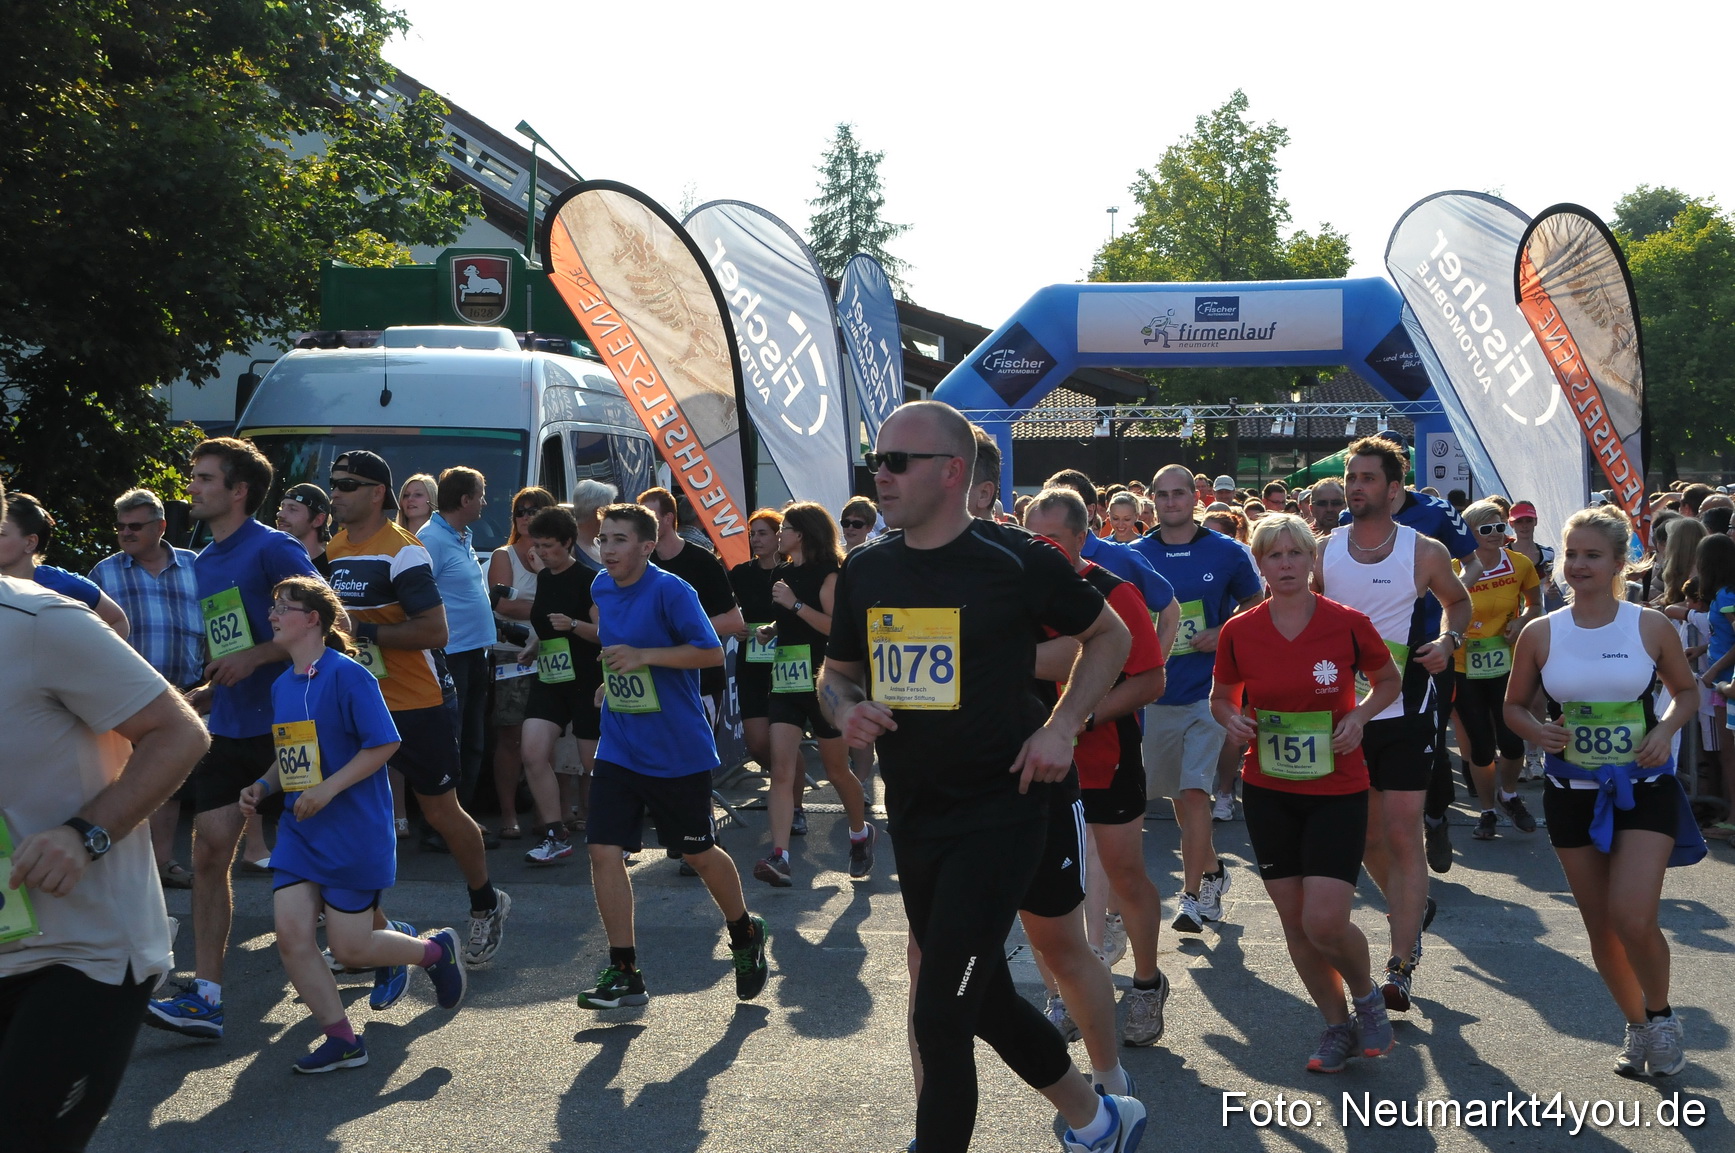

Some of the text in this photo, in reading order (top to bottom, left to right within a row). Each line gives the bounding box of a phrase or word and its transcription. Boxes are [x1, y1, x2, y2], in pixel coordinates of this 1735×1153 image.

[469, 308, 494, 318] 1628
[1204, 306, 1237, 314] Fischer
[1179, 322, 1277, 341] firmenlauf
[993, 358, 1045, 368] Fischer
[1400, 351, 1414, 359] das
[333, 578, 369, 591] Fischer
[1491, 576, 1517, 588] BÖGL
[210, 612, 243, 645] 652
[537, 652, 571, 673] 1142
[872, 643, 955, 685] 1078
[1471, 651, 1505, 669] 812
[773, 661, 809, 682] 1141
[608, 674, 645, 699] 680
[1267, 734, 1316, 763] 151
[1574, 725, 1633, 755] 883
[279, 745, 311, 775] 664
[956, 956, 977, 997] TRIGEMA
